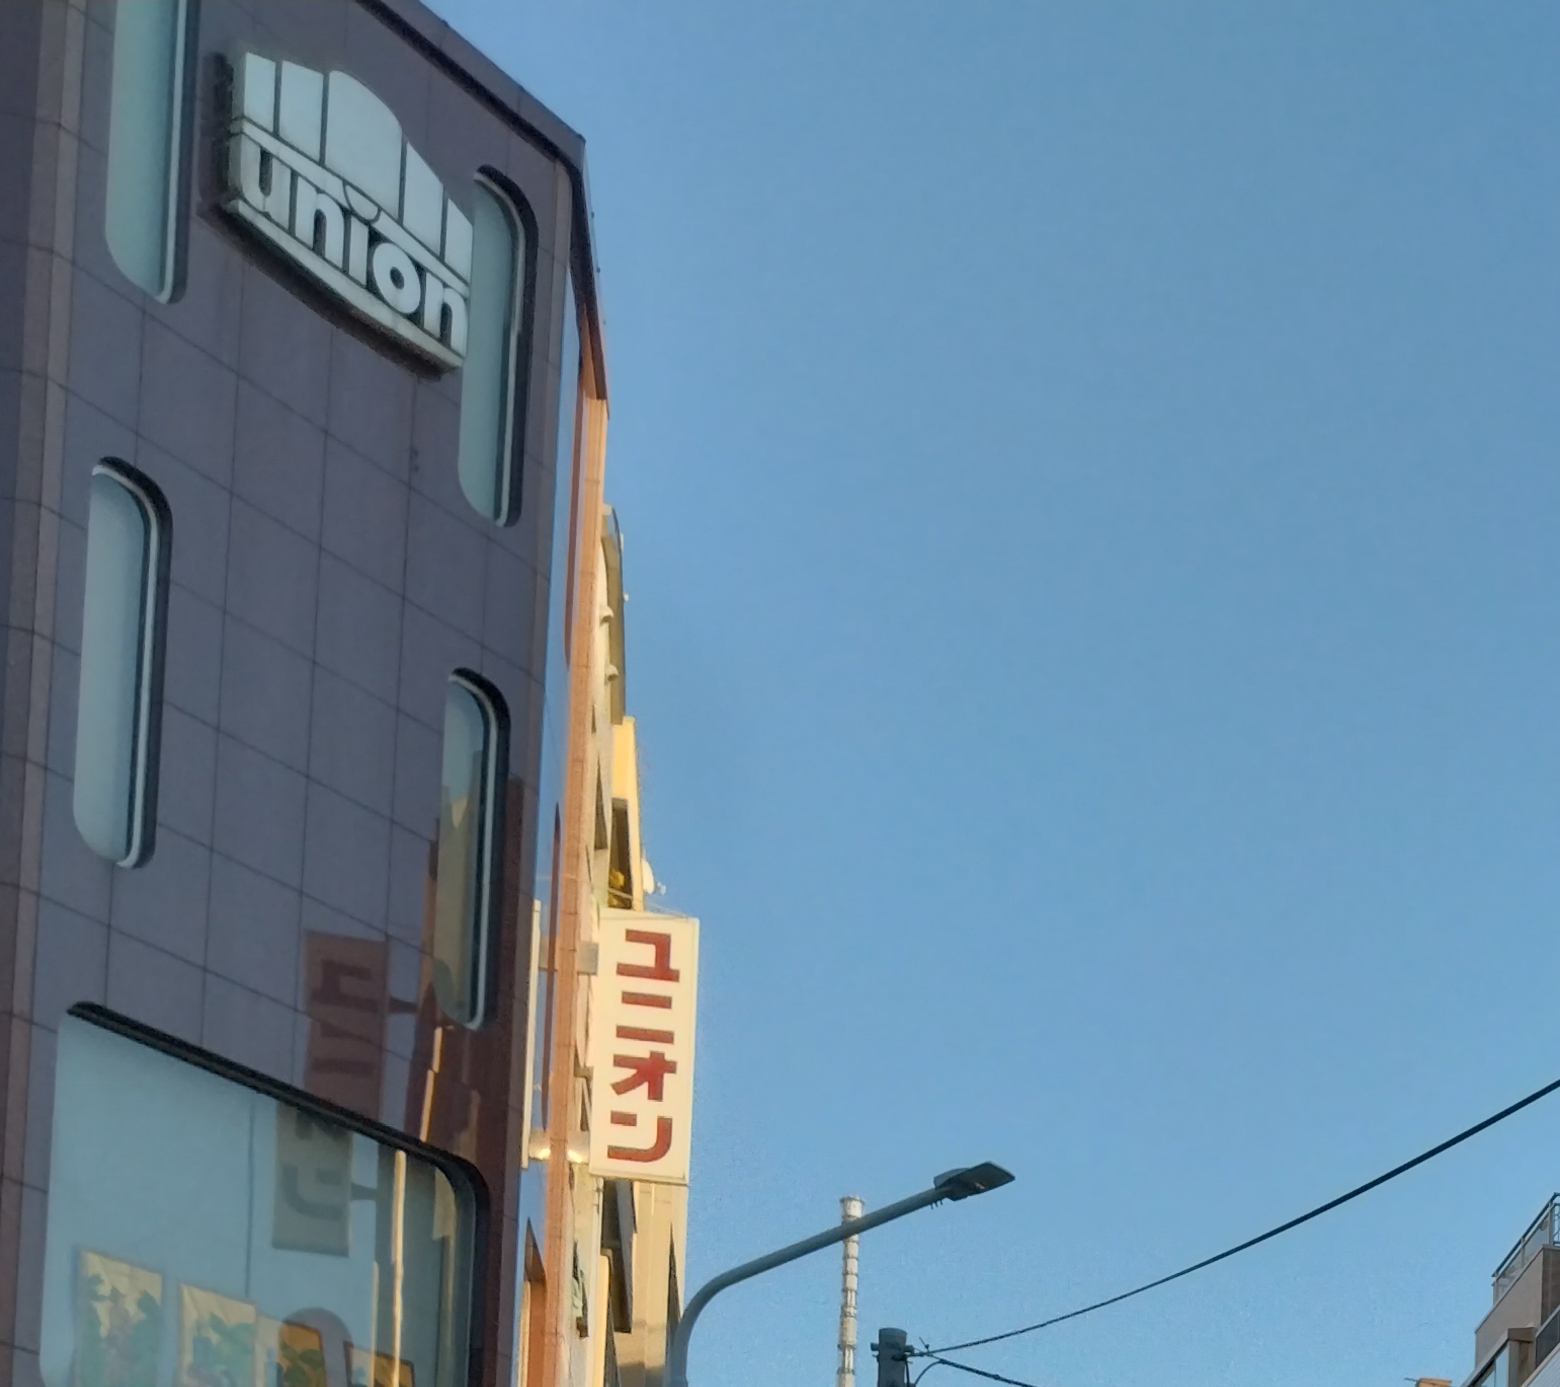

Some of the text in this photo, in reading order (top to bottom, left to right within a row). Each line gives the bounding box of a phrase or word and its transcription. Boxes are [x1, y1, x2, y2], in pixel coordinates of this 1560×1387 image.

[240, 133, 468, 358] union
[607, 928, 680, 1163] ユニオン
